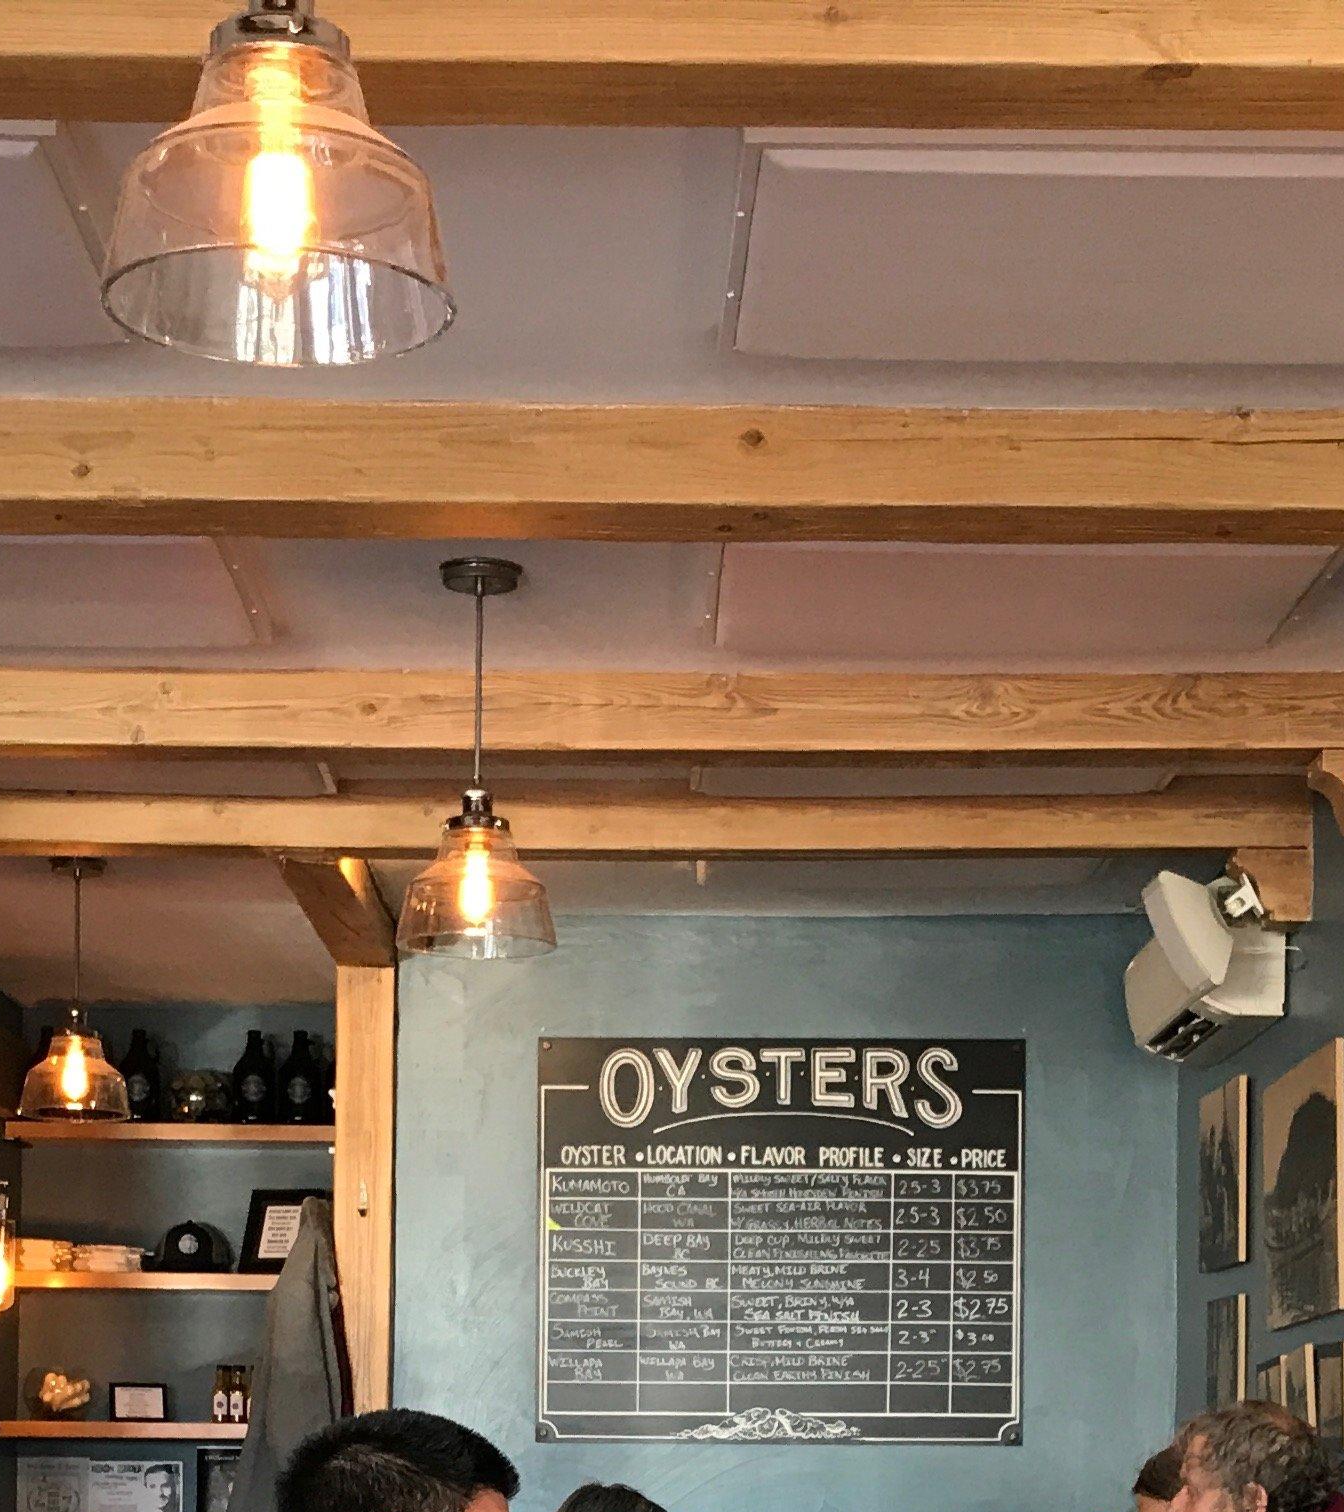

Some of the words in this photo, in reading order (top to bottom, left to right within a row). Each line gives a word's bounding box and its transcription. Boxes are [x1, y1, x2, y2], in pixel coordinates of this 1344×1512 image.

[599, 1046, 963, 1129] OYSTERS
[561, 1145, 626, 1166] OYSTER
[647, 1145, 723, 1166] LOCATION
[740, 1146, 806, 1166] FLAVOR
[819, 1147, 885, 1167] PROFILE
[906, 1149, 942, 1168] SIZE
[961, 1149, 1007, 1168] PRICE
[552, 1177, 630, 1194] KUMAMOTO
[698, 1174, 718, 1186] BAY
[666, 1185, 686, 1197] CA
[550, 1202, 611, 1215] WILDCAT
[643, 1203, 673, 1214] HOOD
[733, 1203, 770, 1213] SWEET
[575, 1214, 612, 1228] COVE
[673, 1217, 694, 1228] WA
[552, 1234, 616, 1256] KUSSHI
[643, 1233, 682, 1247] DEEP
[686, 1234, 711, 1250] BAY
[735, 1234, 763, 1246] DEEP
[844, 1234, 881, 1244] SWEET
[551, 1266, 606, 1279] BUCKLEY
[775, 1264, 807, 1276] MILD
[810, 1263, 848, 1275] BRINE
[582, 1276, 609, 1289] BAY
[895, 1268, 930, 1288] 3-4
[644, 1294, 692, 1307] SAMISH
[577, 1304, 619, 1318] POINT
[693, 1308, 714, 1320] WA
[744, 1308, 771, 1321] SEA
[775, 1309, 806, 1321] SALT
[809, 1310, 860, 1322] FINISH
[896, 1299, 932, 1319] 2-3
[701, 1324, 721, 1338] BAY
[734, 1325, 773, 1337] SWEET
[668, 1340, 686, 1350] WA
[548, 1354, 603, 1367] WILLAPA
[640, 1355, 686, 1369] WILLAPA
[692, 1355, 715, 1371] BAY
[573, 1366, 603, 1381] BAY
[664, 1369, 685, 1381] WA
